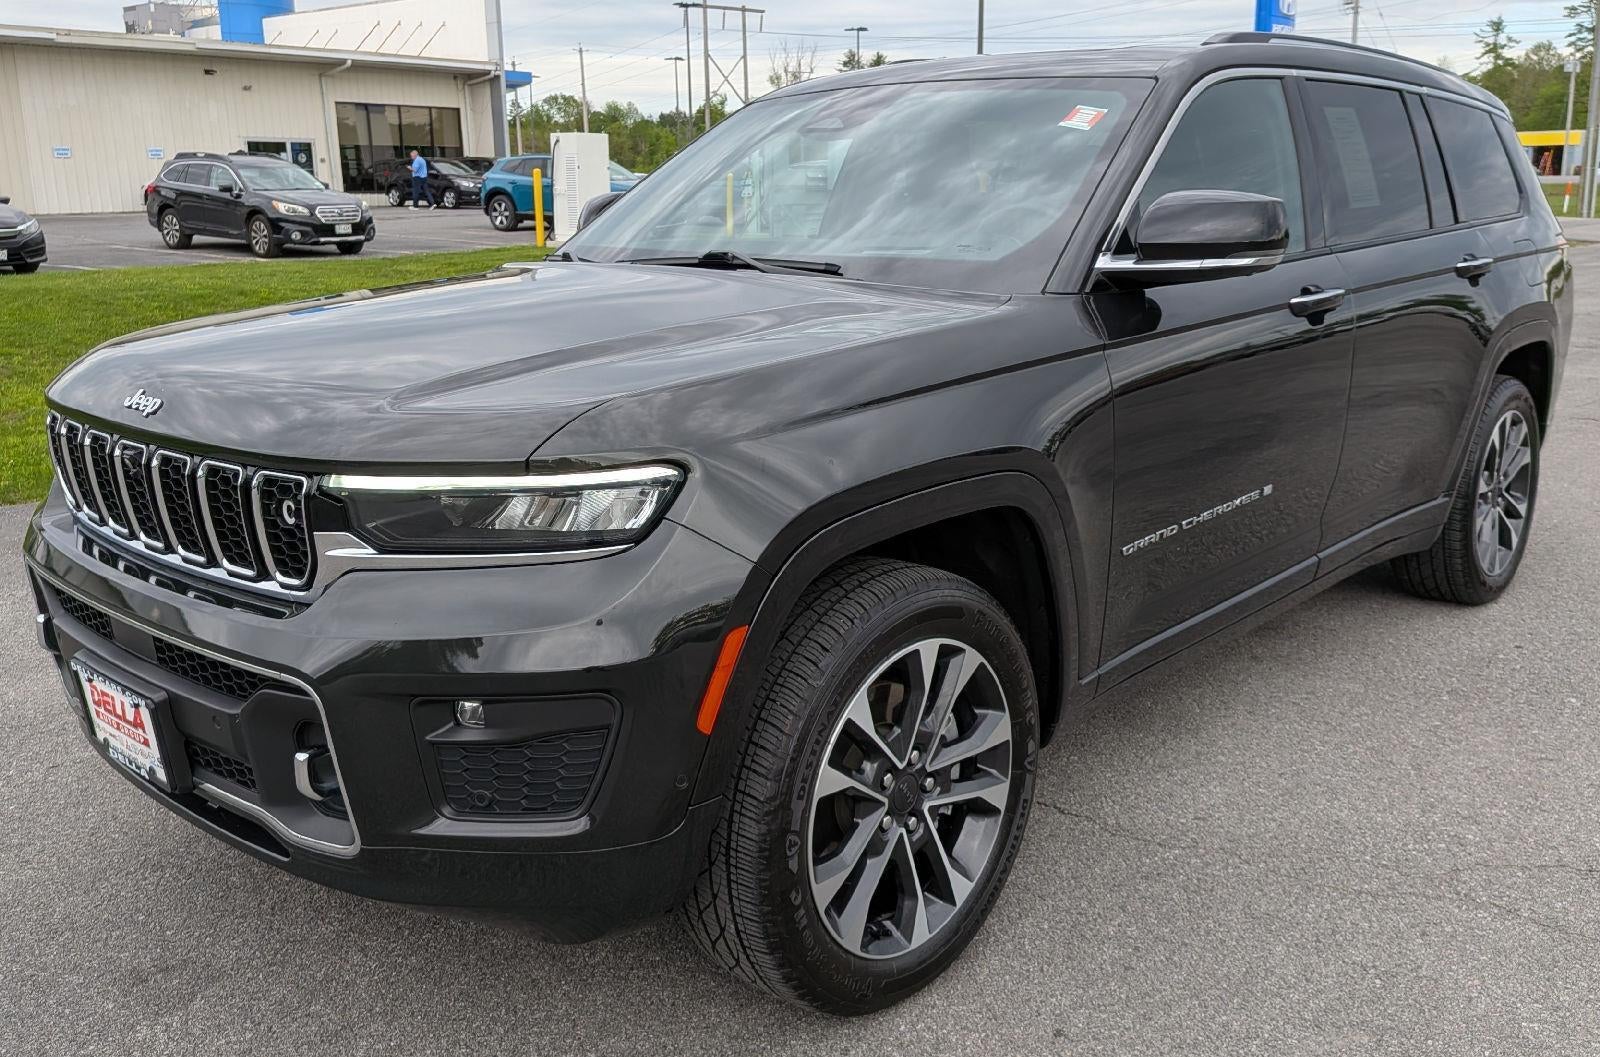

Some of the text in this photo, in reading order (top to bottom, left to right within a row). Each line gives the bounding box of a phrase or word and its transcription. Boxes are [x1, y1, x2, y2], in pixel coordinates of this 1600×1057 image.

[124, 389, 162, 417] Jeep
[1121, 490, 1261, 557] GRAND CHEROKEE
[89, 683, 148, 736] DELLA
[120, 725, 145, 743] GROUP
[109, 748, 150, 780] DELLA
